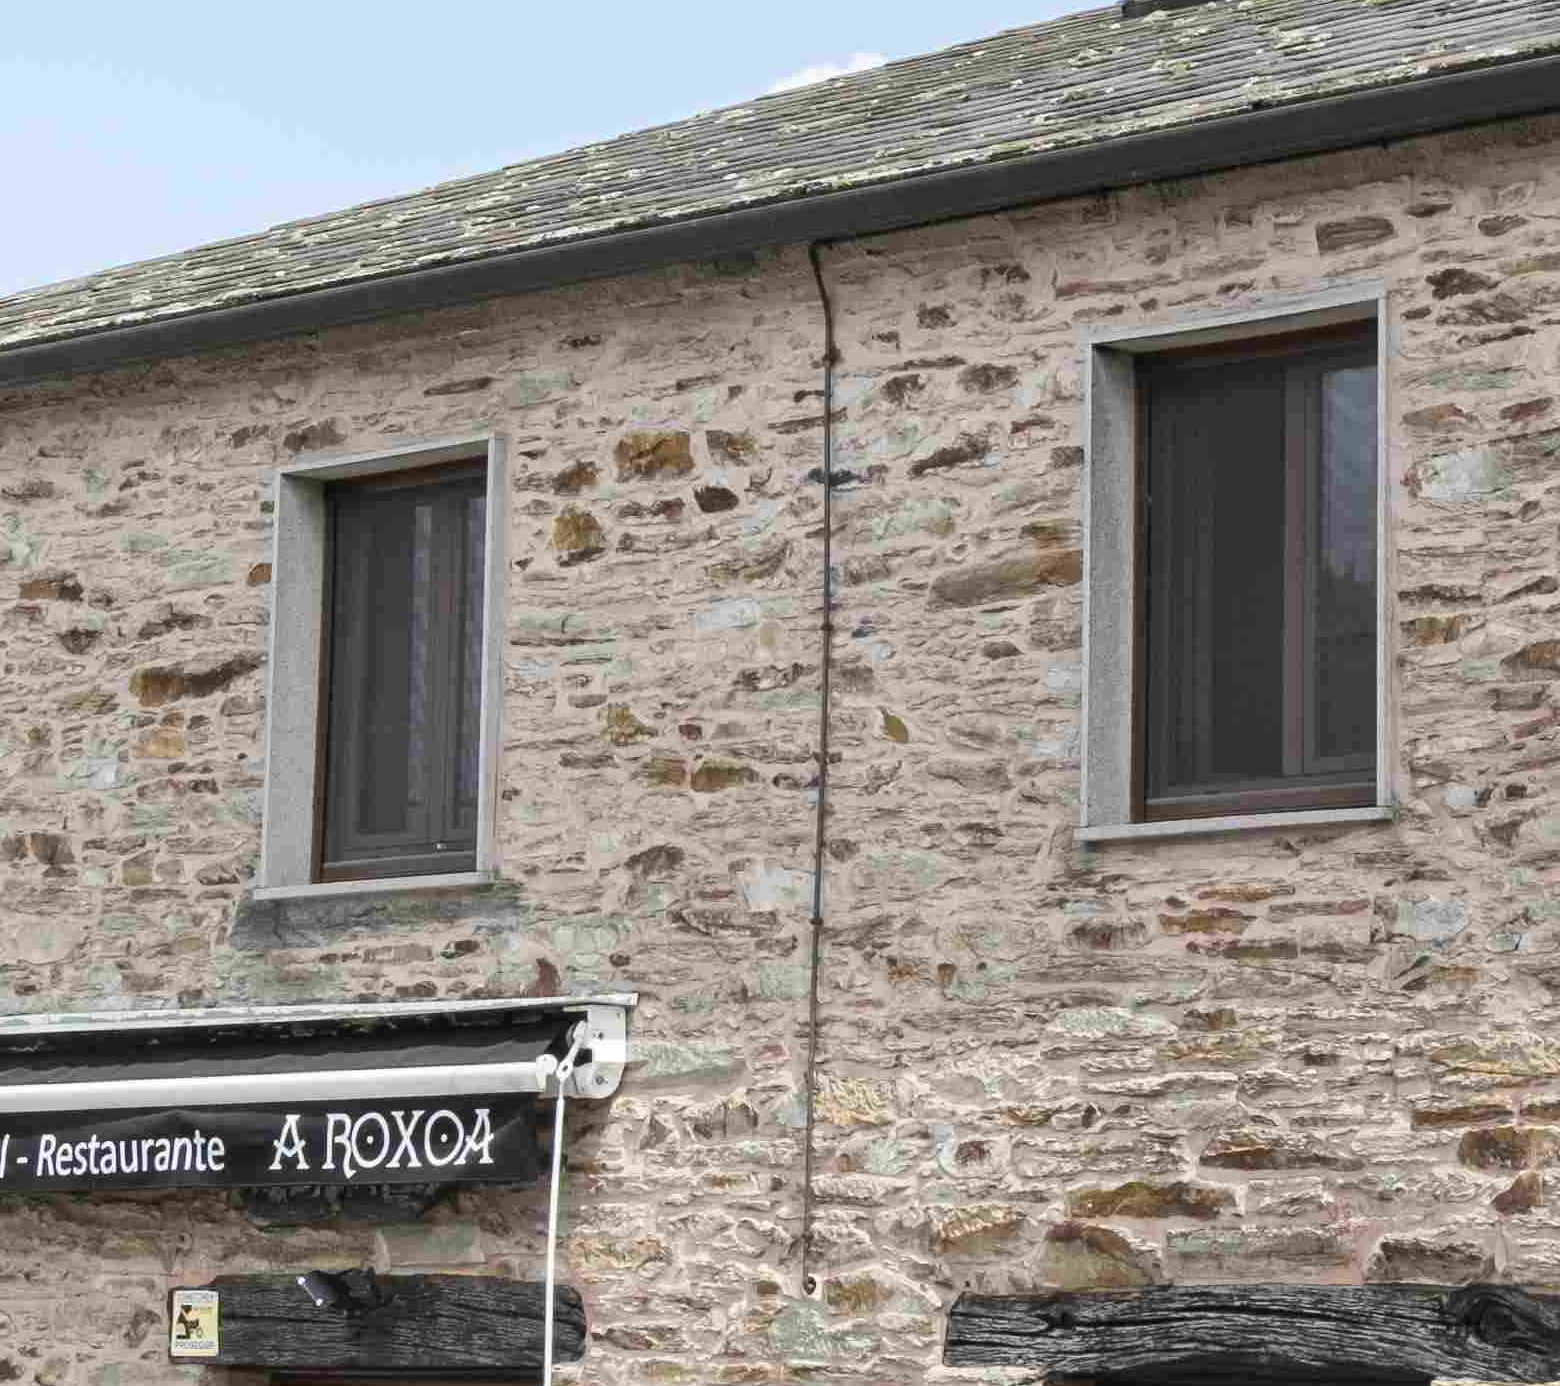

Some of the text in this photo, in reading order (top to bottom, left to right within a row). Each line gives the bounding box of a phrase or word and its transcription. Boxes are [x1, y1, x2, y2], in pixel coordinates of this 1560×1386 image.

[36, 1129, 226, 1177] Restaurante
[268, 1114, 310, 1170] A
[321, 1108, 495, 1179] ROXOA
